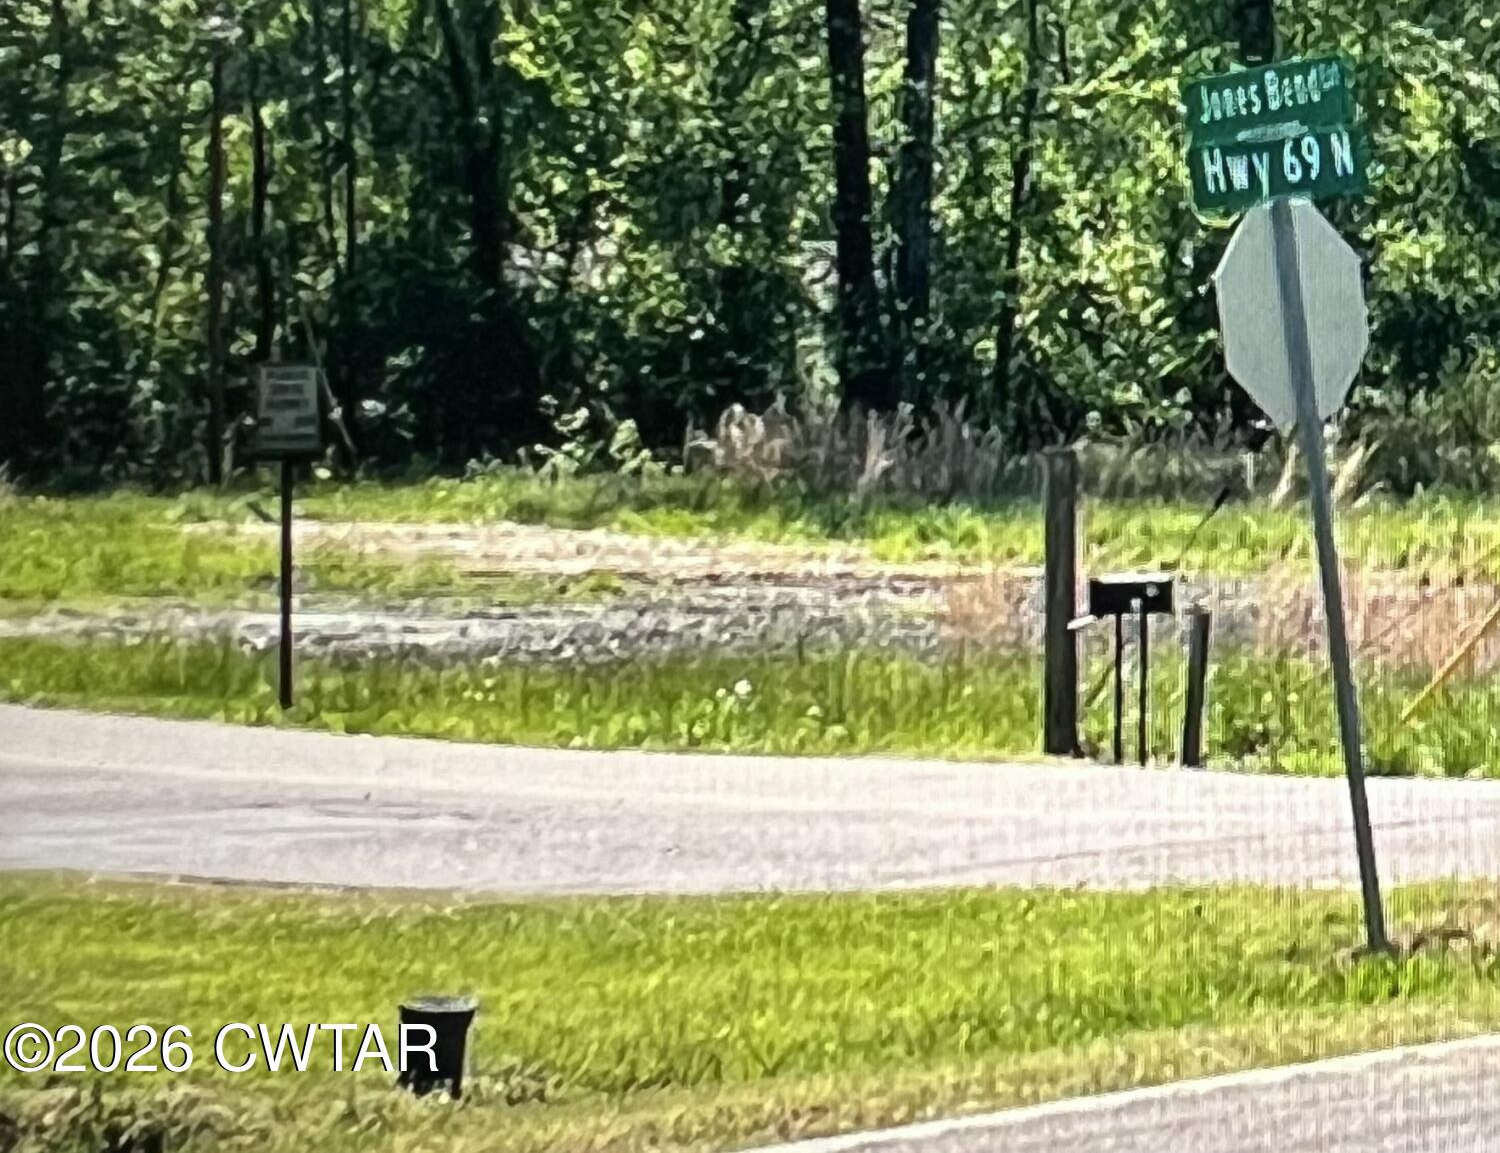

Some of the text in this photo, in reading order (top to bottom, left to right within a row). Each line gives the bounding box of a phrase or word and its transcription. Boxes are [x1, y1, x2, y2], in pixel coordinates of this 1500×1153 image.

[1200, 82, 1261, 123] Jones
[1203, 148, 1269, 202] Hwy
[1283, 135, 1320, 183] 69
[1330, 131, 1354, 177] N
